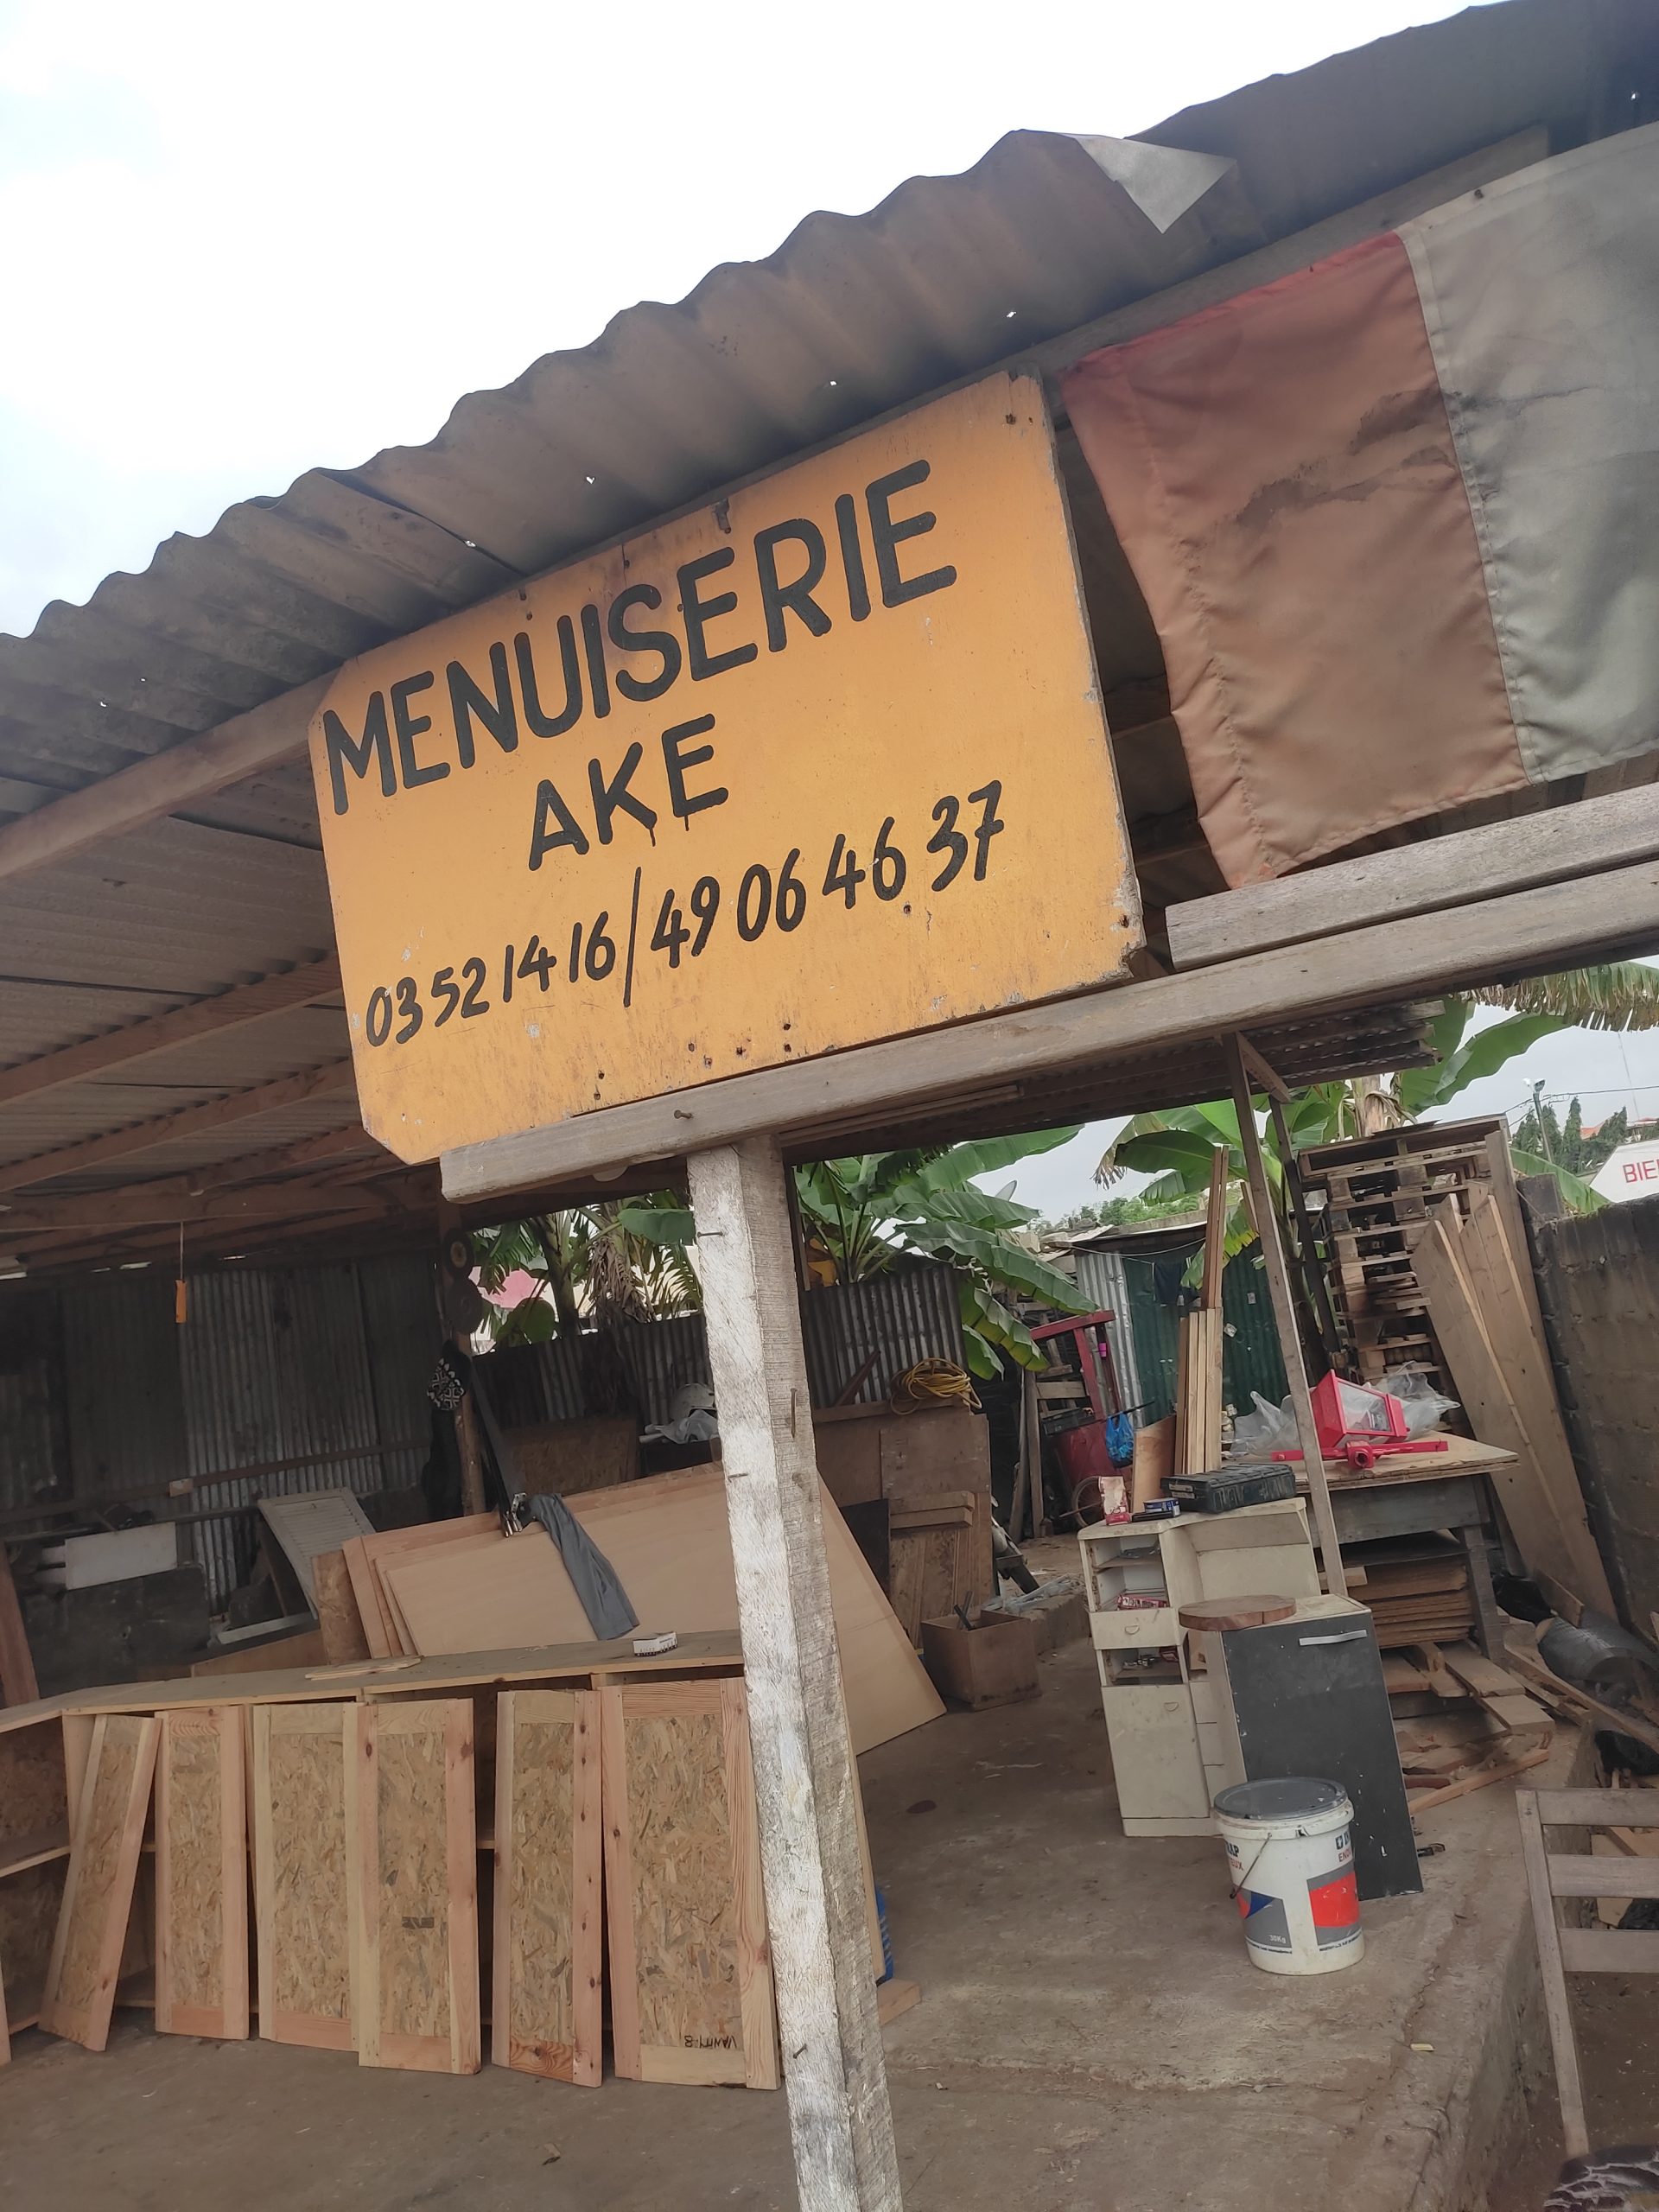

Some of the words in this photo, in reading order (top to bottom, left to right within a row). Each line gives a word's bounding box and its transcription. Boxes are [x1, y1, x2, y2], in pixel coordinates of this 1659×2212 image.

[321, 458, 958, 816] MENUISERIE
[528, 713, 729, 872] AKE
[1623, 1159, 1659, 1183] BIE
